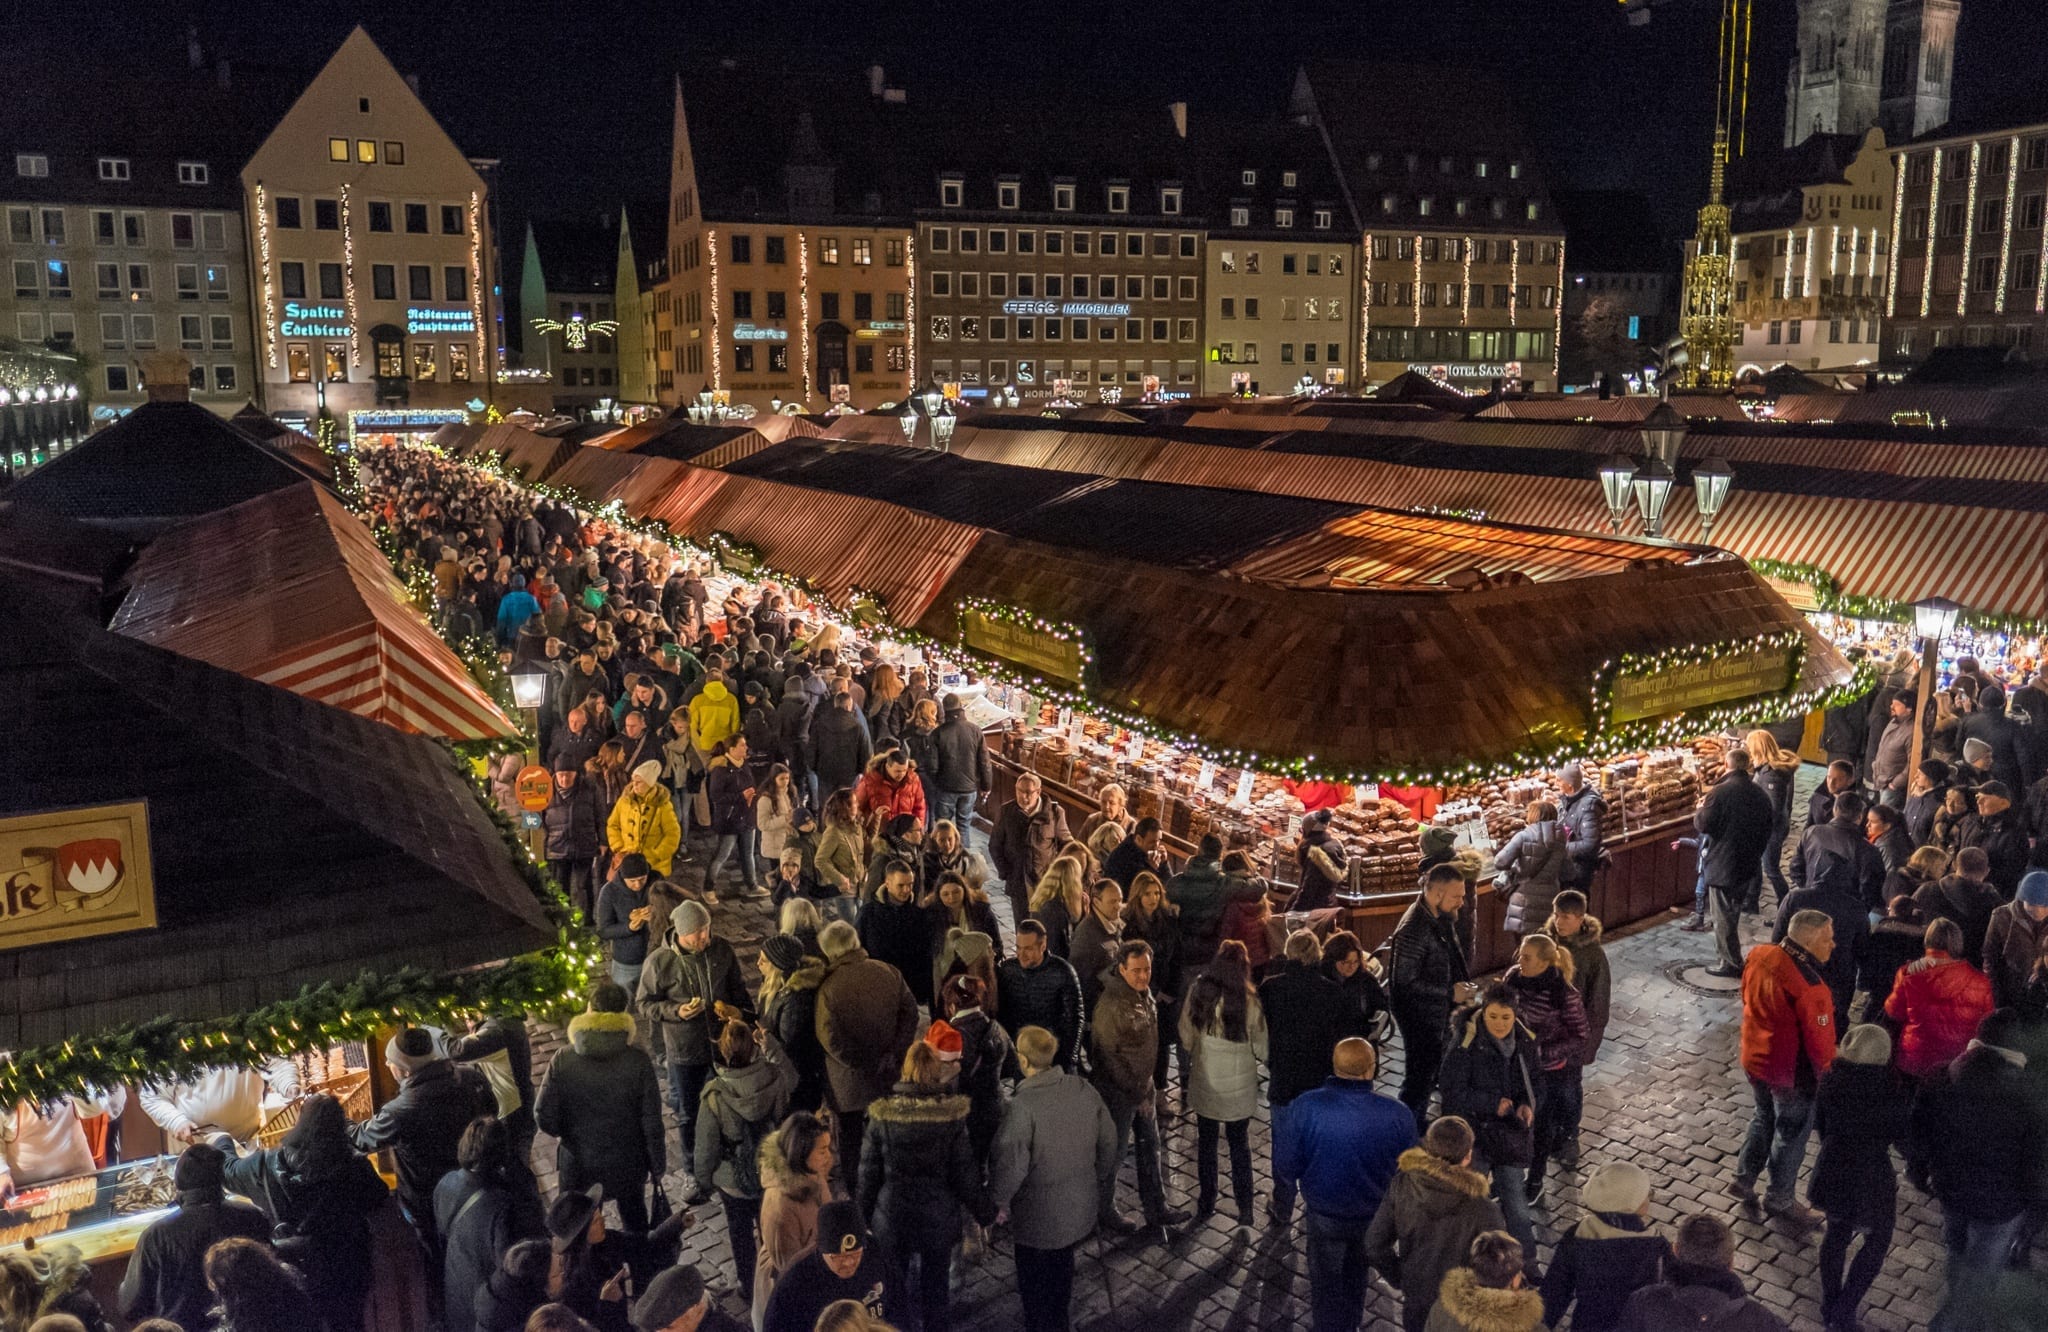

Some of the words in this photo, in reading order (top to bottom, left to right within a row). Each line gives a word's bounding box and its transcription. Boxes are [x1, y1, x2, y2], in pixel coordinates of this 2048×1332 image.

[285, 302, 344, 319] Spalter
[408, 308, 473, 319] Restaurant
[1063, 303, 1130, 315] IMMOBILIEN
[281, 321, 351, 336] Edelbiere
[408, 321, 475, 334] Hauptmarkt
[526, 815, 537, 825] WC
